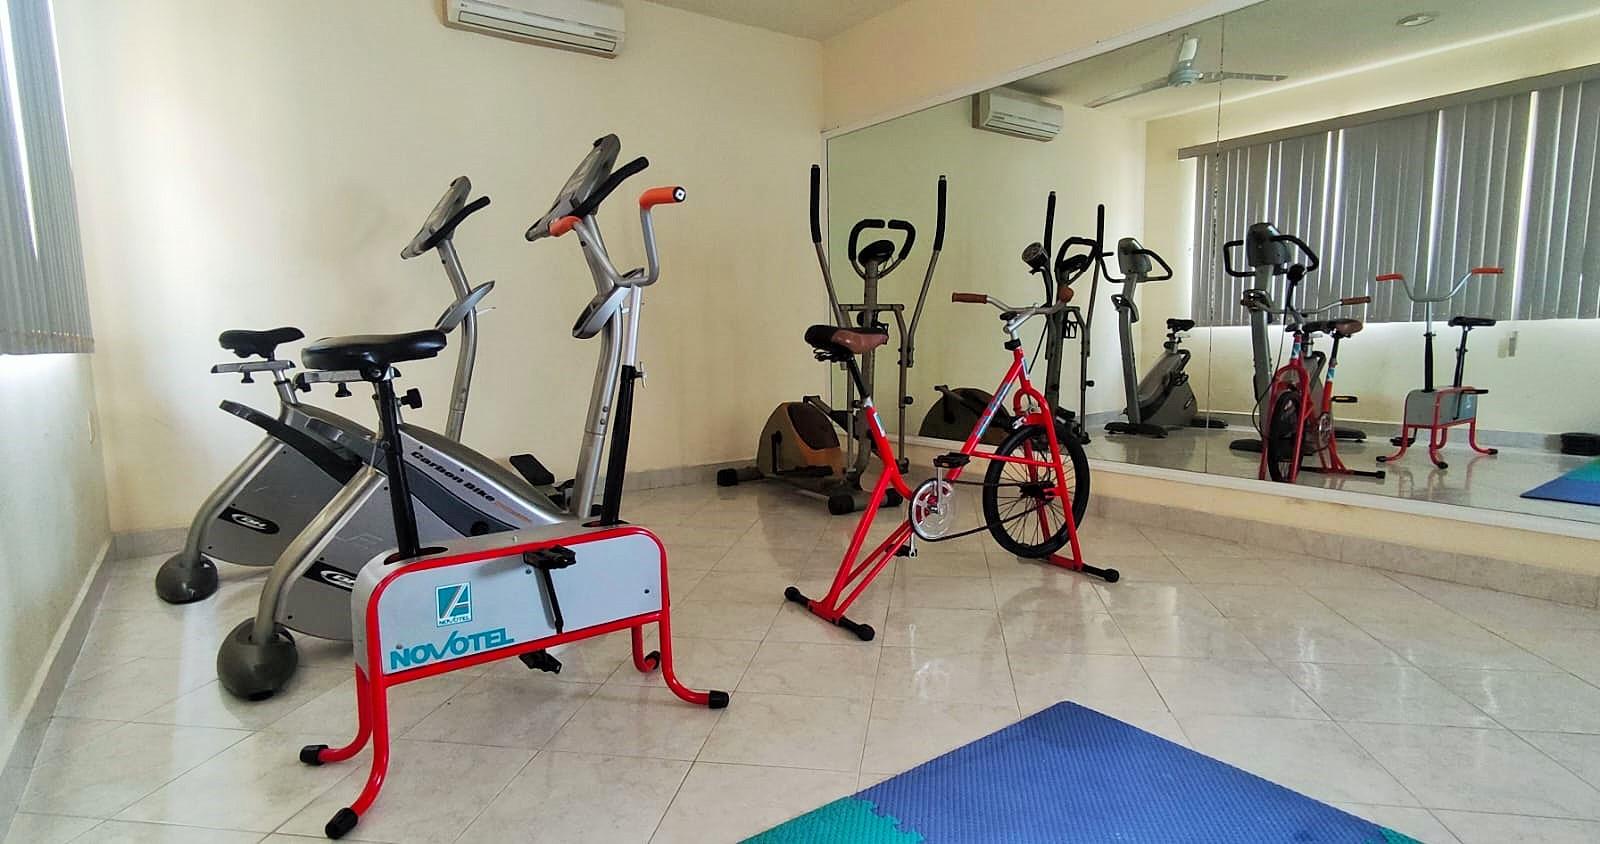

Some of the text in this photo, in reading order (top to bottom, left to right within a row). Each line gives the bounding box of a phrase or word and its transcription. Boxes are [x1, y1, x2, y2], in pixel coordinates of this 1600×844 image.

[411, 451, 496, 502] Carbon Bike
[390, 627, 514, 670] NOVOTEL
